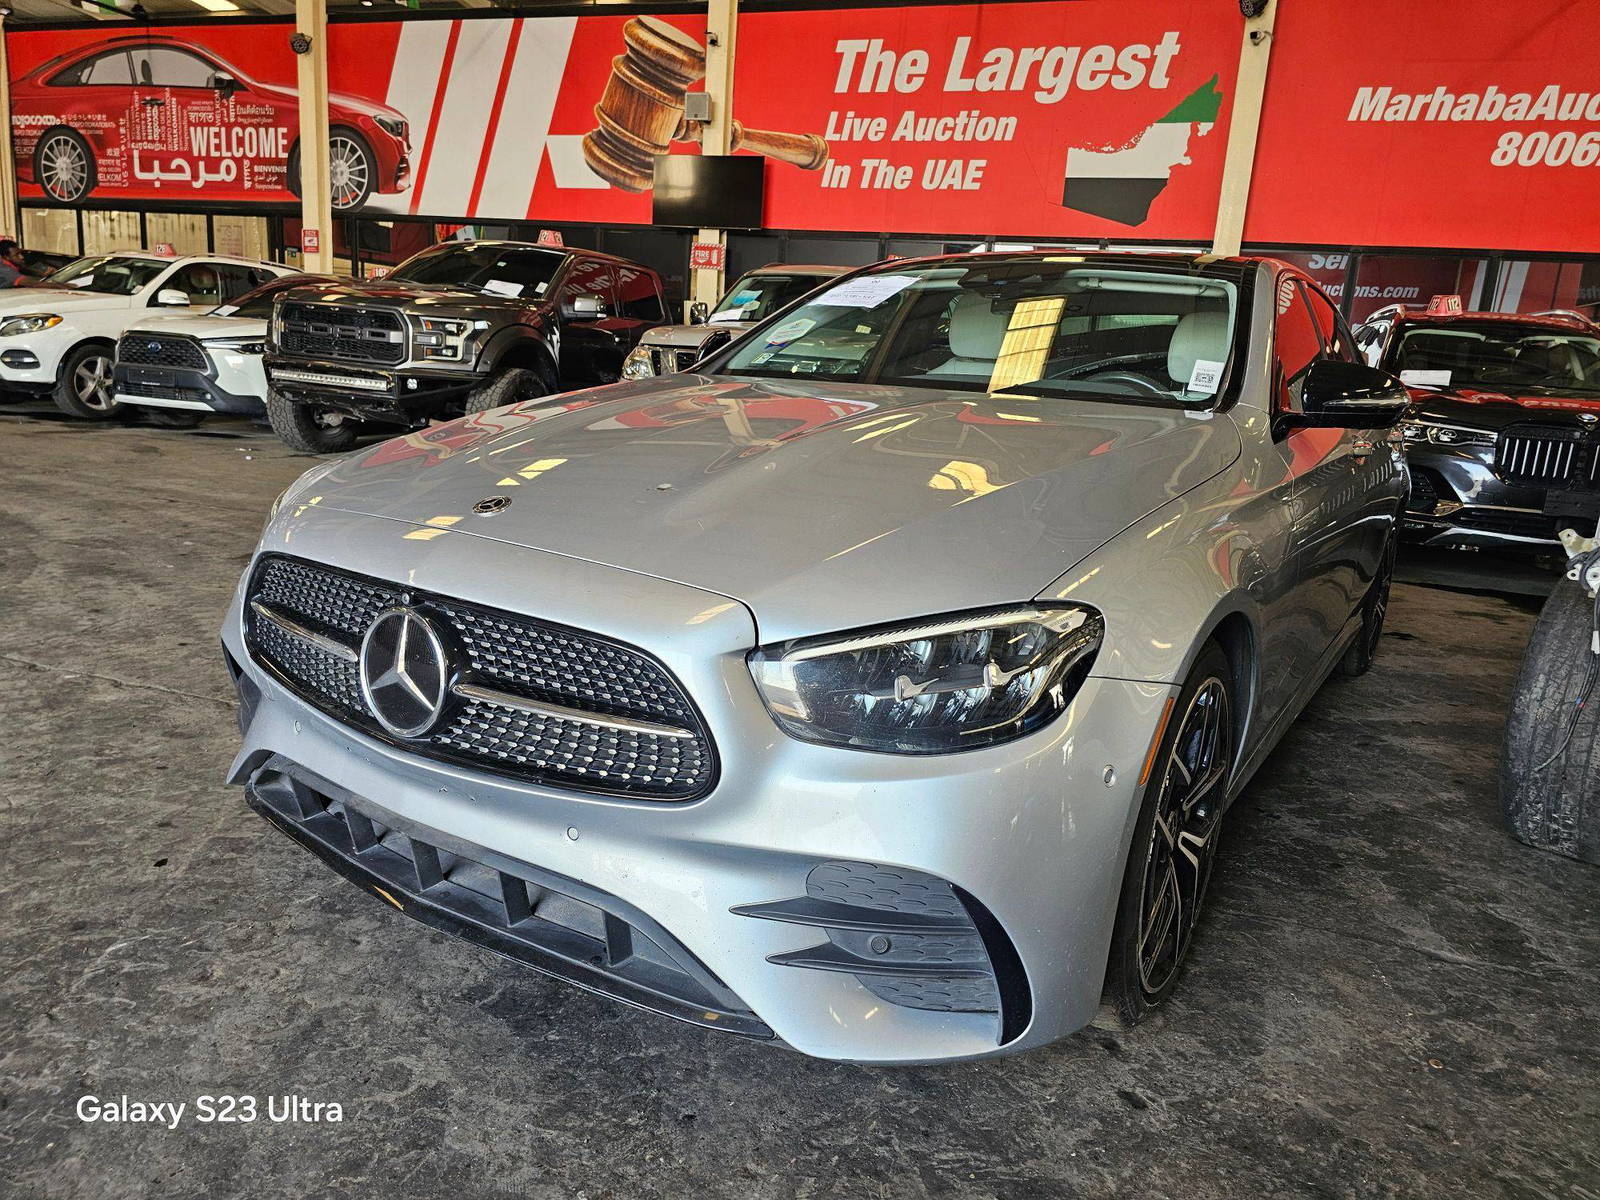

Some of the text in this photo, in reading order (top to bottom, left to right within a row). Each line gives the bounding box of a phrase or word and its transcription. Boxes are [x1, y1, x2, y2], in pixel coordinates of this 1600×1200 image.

[834, 31, 1181, 104] The Largest
[189, 126, 288, 158] WELCOME
[824, 109, 1018, 142] Live Auction
[1490, 131, 1600, 168] 8006
[98, 172, 121, 182] ELKOM
[133, 149, 237, 189] مرحبا
[821, 158, 987, 191] In The UAE
[1447, 296, 1460, 311] 112
